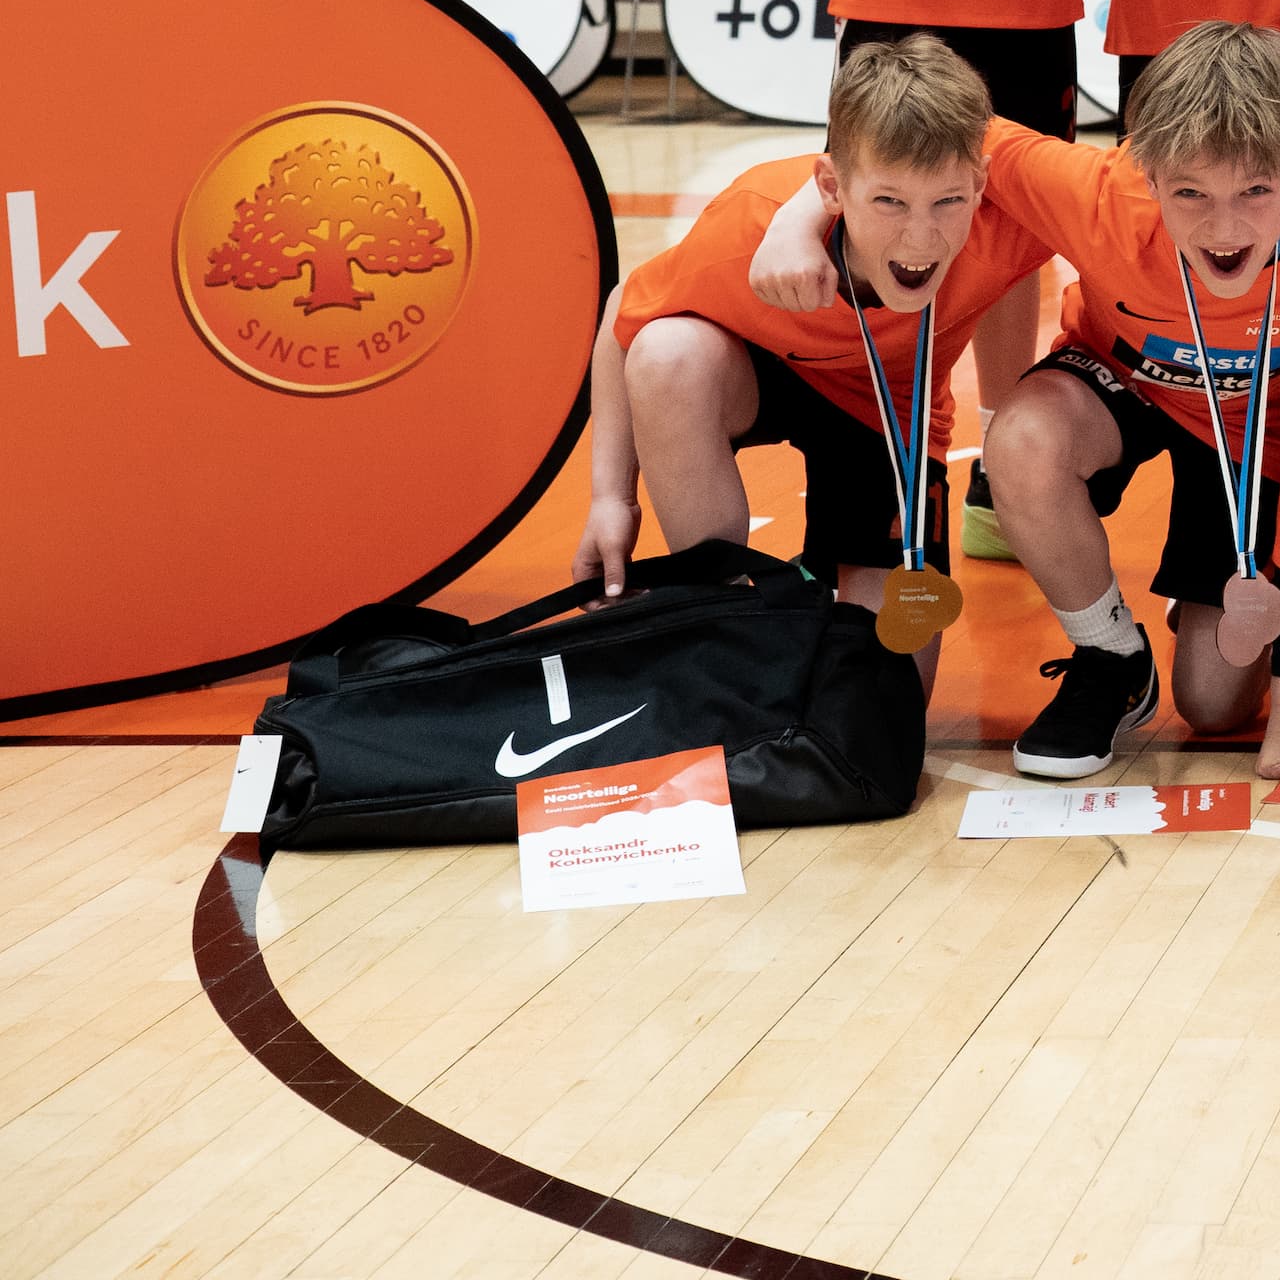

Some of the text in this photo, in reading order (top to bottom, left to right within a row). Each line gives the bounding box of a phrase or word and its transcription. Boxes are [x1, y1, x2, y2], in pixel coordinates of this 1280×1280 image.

[237, 302, 426, 370] SINCE 1820
[544, 783, 637, 804] Noorteliiga
[548, 838, 648, 858] Oleksandr
[550, 842, 701, 869] Kolomyichenko
